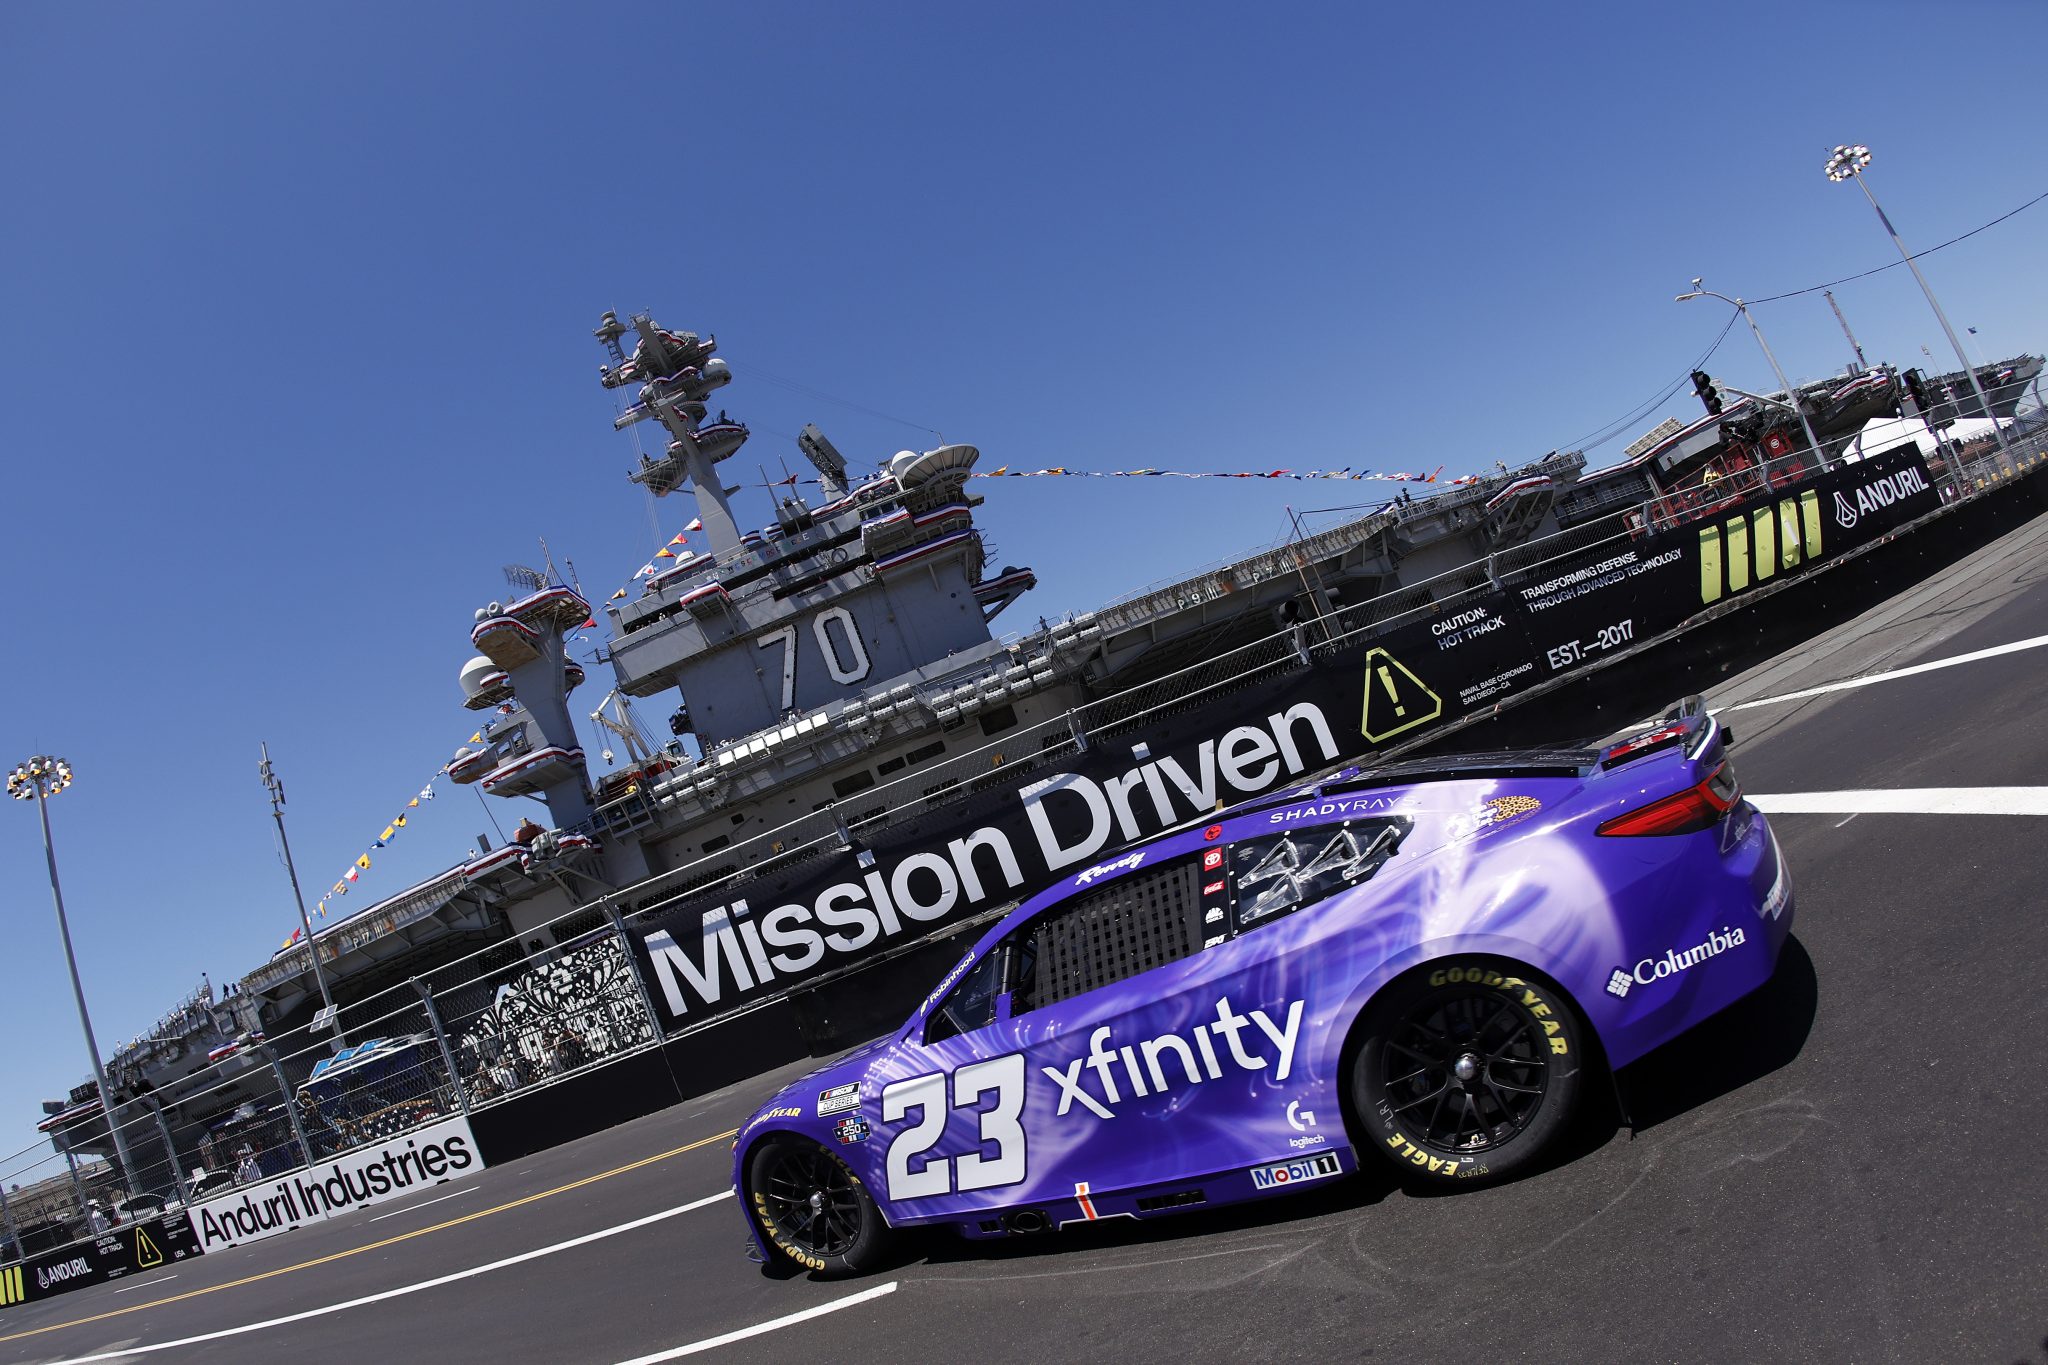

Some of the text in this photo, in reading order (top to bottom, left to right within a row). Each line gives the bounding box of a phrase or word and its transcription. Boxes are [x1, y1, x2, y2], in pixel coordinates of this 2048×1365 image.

[1855, 467, 1929, 516] ANDURIL
[1520, 551, 1638, 600] TRANSFORMING DEFENSE
[1526, 548, 1682, 614] THROUGH ADVANCED TECHNOLOGY
[1431, 606, 1488, 637] CAUTION:
[1437, 615, 1506, 651] HOT TRACK
[756, 606, 873, 711] 70
[1459, 662, 1533, 698] NAVAL BASE CORONADO
[1462, 692, 1477, 706] SAN
[643, 701, 1341, 1018] Mission Driven
[930, 951, 975, 1004] Robinhood
[1633, 926, 1746, 985] Columbia
[1041, 996, 1304, 1118] xfinity
[842, 1124, 862, 1136] 250
[880, 1053, 1027, 1202] 23
[1289, 1134, 1325, 1149] logitech
[1255, 1158, 1332, 1187] Mobil 1
[1386, 1132, 1460, 1177] EAGLE
[200, 1136, 472, 1247] Anduril Industries
[49, 1257, 93, 1284] ANDURIL
[99, 1242, 124, 1256] HOT TRACK
[174, 1249, 186, 1259] USA
